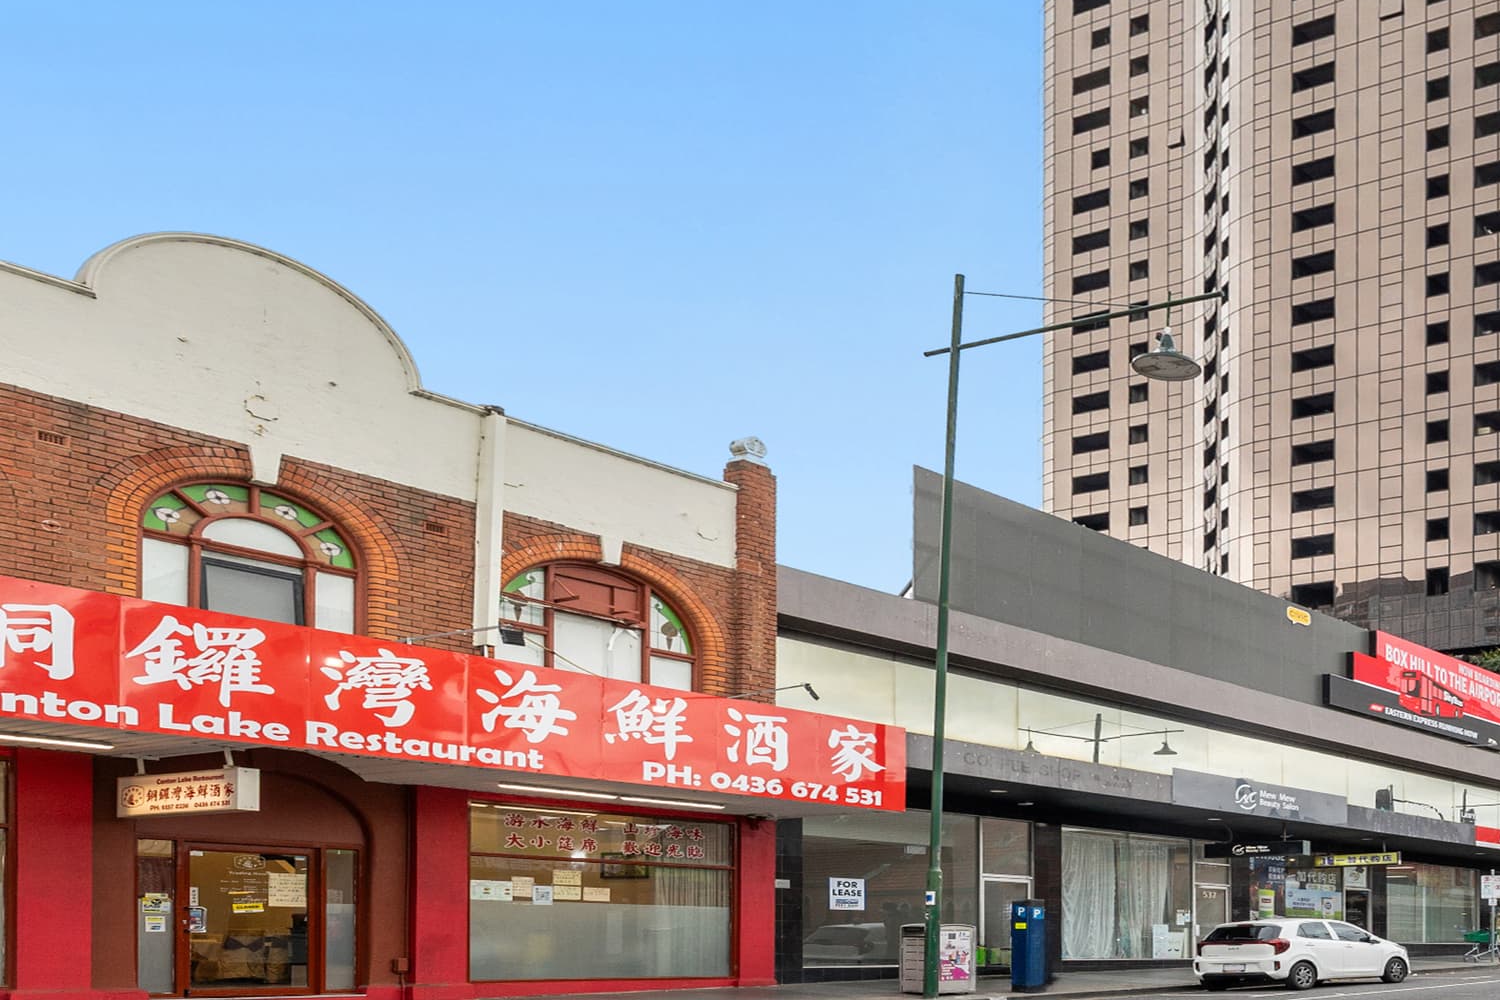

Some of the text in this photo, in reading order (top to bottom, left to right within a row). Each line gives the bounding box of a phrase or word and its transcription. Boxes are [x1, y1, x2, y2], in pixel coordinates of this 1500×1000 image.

[1385, 643, 1408, 669] BOX
[1409, 654, 1433, 678] HILL
[1434, 664, 1447, 685] TO
[1448, 671, 1467, 694] THE
[158, 703, 291, 742] Lake
[304, 720, 544, 770] Restaurant
[642, 760, 883, 807] PH: 0436 674 531
[1282, 801, 1300, 811] Salon
[836, 880, 858, 889] FOR
[832, 888, 863, 897] LEASE
[1017, 906, 1026, 917] P
[1033, 908, 1041, 919] P
